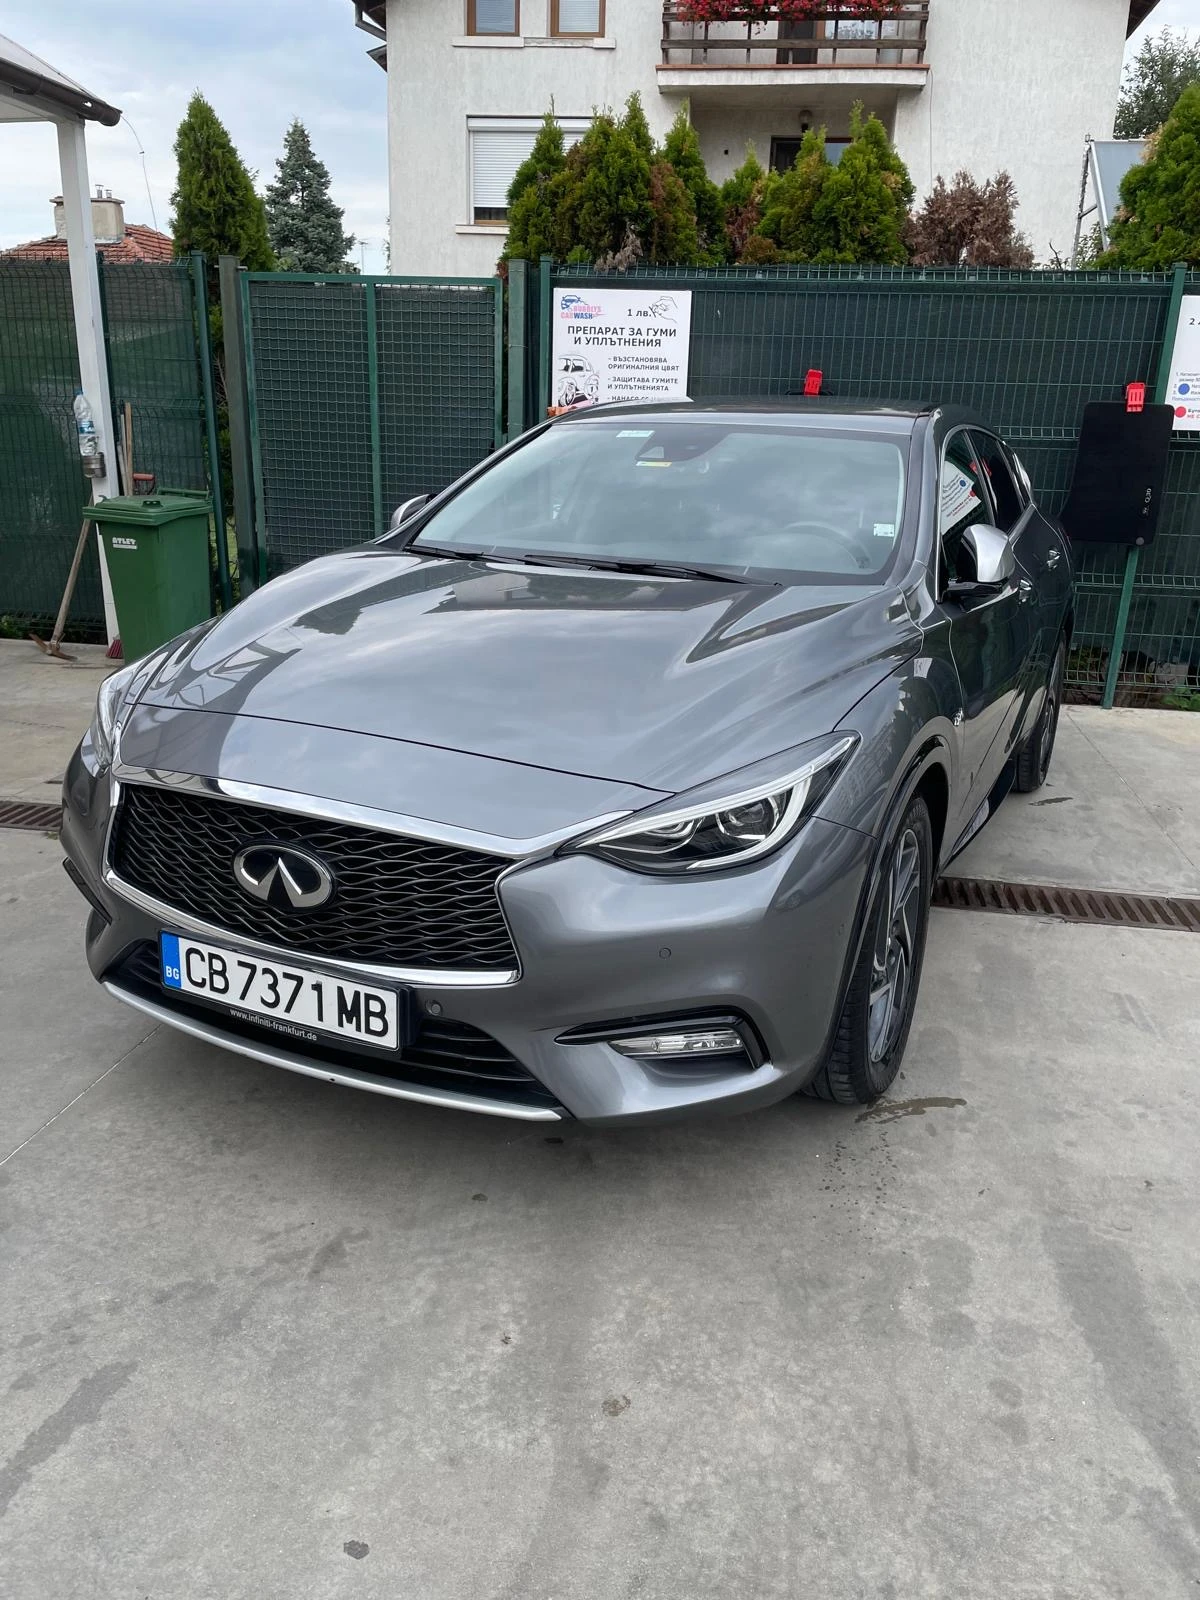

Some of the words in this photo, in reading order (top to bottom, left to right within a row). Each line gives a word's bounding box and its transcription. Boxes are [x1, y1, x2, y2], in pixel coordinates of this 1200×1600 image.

[627, 309, 632, 317] 1
[1188, 317, 1195, 326] 2
[567, 325, 625, 336] ПРЕПАРАТ
[628, 327, 643, 337] ЗА
[646, 327, 677, 337] ГУМИ
[574, 336, 581, 345] И
[585, 337, 662, 347] УПЛЪТНЕНИЯ
[608, 363, 659, 371] ОРИГИНАЛНИЯ
[612, 376, 650, 384] ЗАЩИТАВА
[651, 377, 679, 385] ГУМИТЕ
[614, 384, 669, 392] УПЛЪТНЕНИЯТА
[165, 965, 180, 980] BG
[185, 947, 230, 995] CB
[237, 959, 324, 1023] 7371
[336, 985, 389, 1038] MB
[229, 1008, 318, 1041] www.infiniti-frankfurt.de
